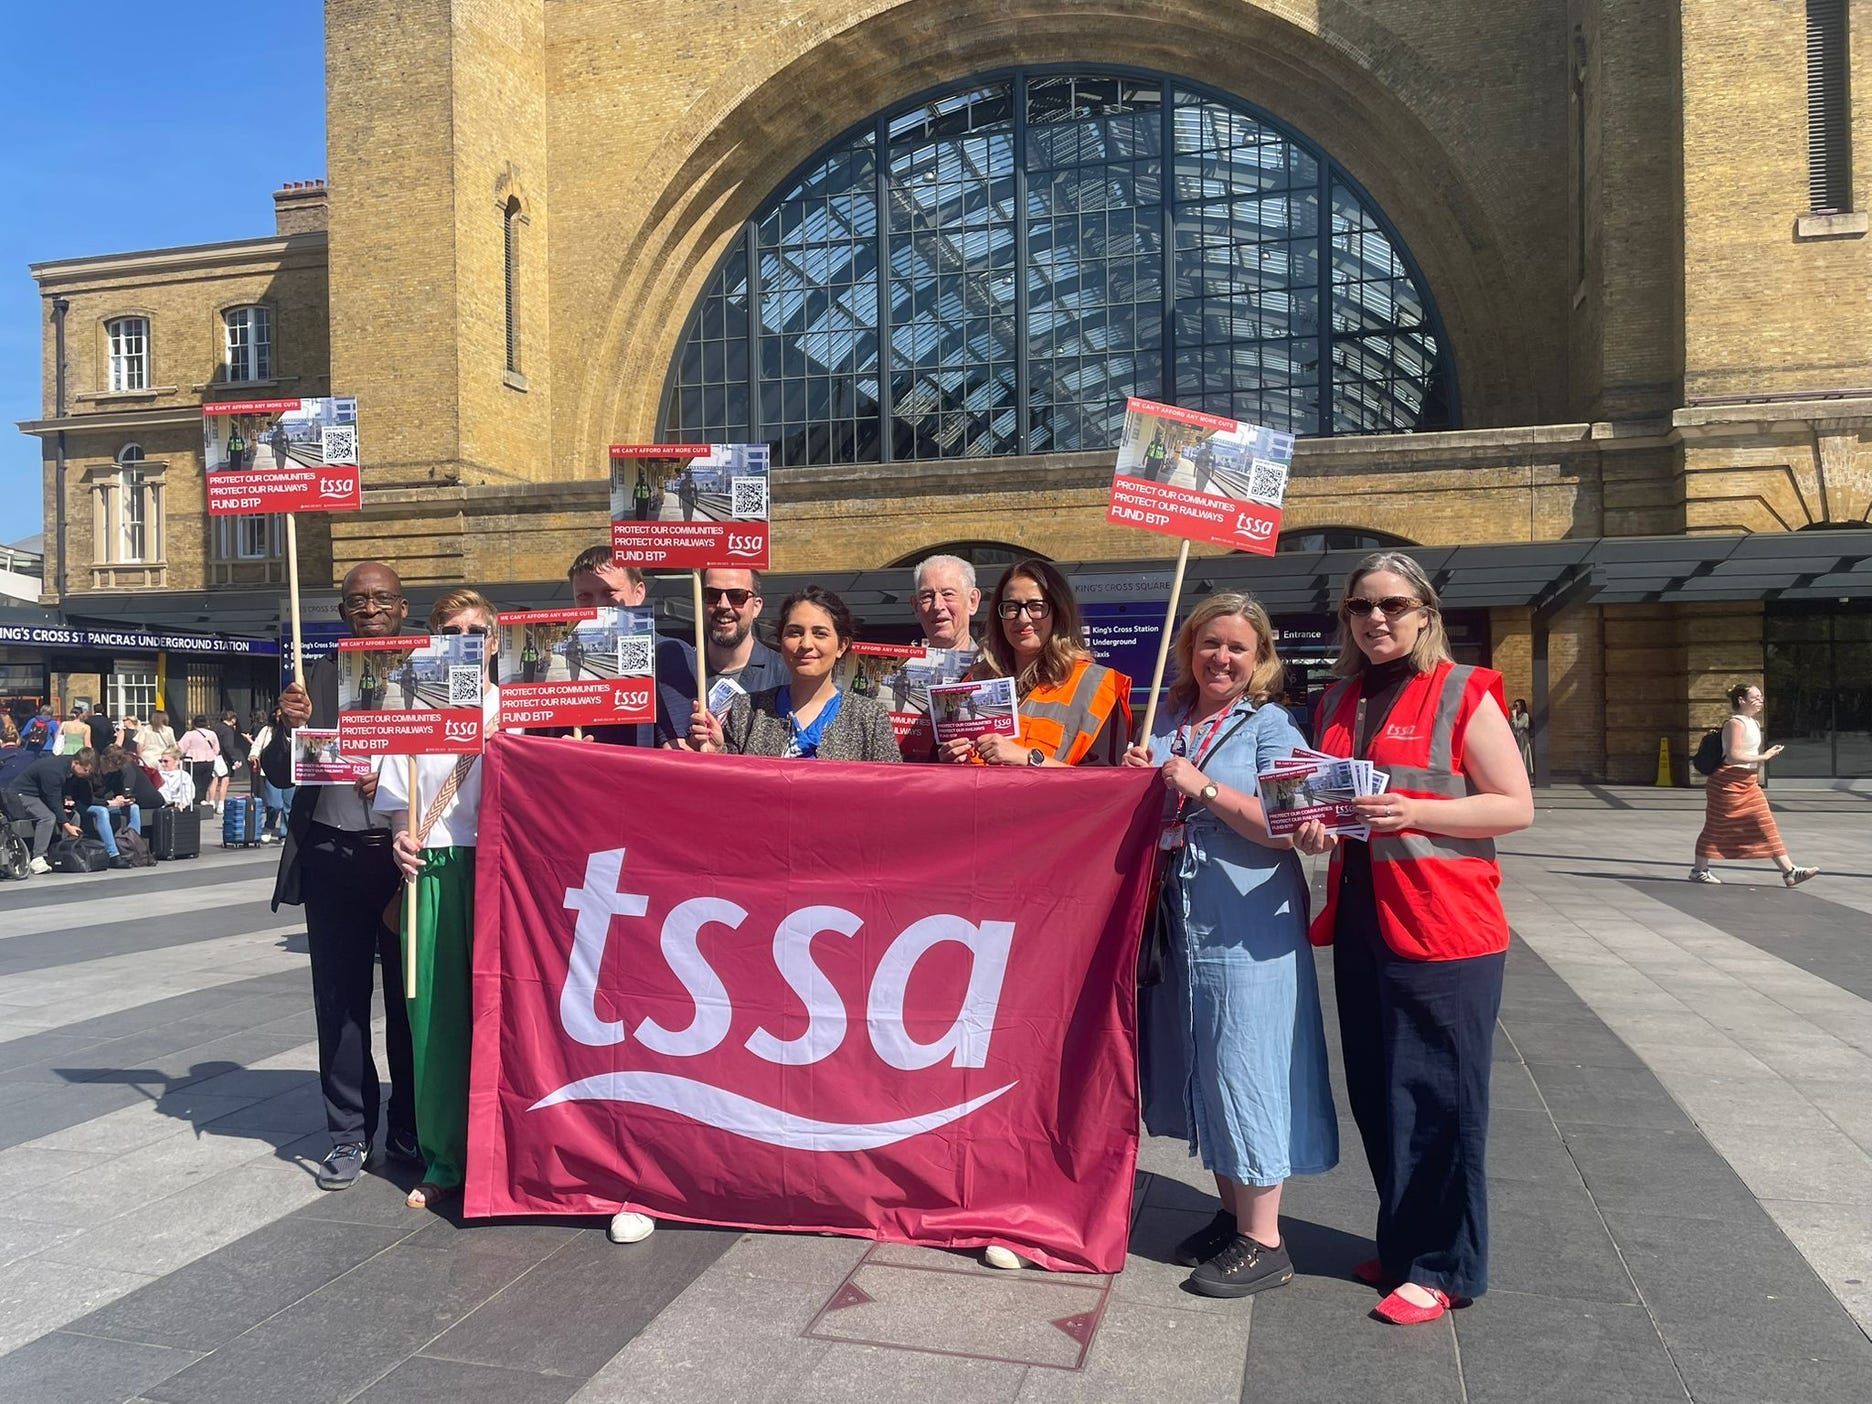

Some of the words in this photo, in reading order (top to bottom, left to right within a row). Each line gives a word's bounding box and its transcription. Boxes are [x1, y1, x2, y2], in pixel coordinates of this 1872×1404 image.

[1141, 403, 1160, 412] CAN'T
[1160, 407, 1186, 418] AFFORD
[1186, 413, 1199, 421] ANY
[1199, 416, 1217, 424] MORE
[1217, 419, 1234, 428] CUTS
[209, 474, 244, 485] PROTECT
[246, 473, 263, 483] OUR
[263, 472, 315, 482] COMMUNITIES
[210, 485, 247, 496] PROTECT
[248, 485, 267, 494] OUR
[267, 483, 308, 493] RAILWAYS
[320, 477, 354, 493] tssa
[1116, 480, 1157, 495] PROTECT
[1157, 489, 1178, 500] OUR
[1177, 493, 1236, 512] COMMUNITIES
[211, 499, 240, 509] FUND
[240, 498, 261, 508] BTP
[1114, 493, 1158, 508] PROTECT
[1158, 503, 1179, 513] OUR
[1179, 506, 1225, 523] RAILWAYS
[1111, 506, 1145, 521] FUND
[1145, 513, 1170, 526] BTP
[1236, 512, 1273, 535] tssa
[614, 526, 650, 534] PROTECT
[651, 526, 669, 534] OUR
[669, 526, 724, 535] COMMUNITIES
[614, 538, 653, 546] PROTECT
[653, 538, 673, 546] OUR
[673, 538, 715, 547] RAILWAYS
[728, 533, 763, 550] tssa
[615, 551, 644, 560] FUND
[645, 551, 666, 561] BTP
[1075, 583, 1102, 593] KING'S
[1105, 582, 1133, 592] CROSS
[1135, 581, 1171, 591] SQUARE
[1092, 626, 1112, 635] King's
[1133, 625, 1159, 633] Station
[1283, 630, 1322, 639] Entrance
[0, 626, 30, 640] ING'S
[33, 629, 70, 642] CROSS
[72, 631, 87, 643] ST.
[88, 633, 136, 646] PANCRAS
[138, 636, 212, 650] UNDERGROUND
[213, 640, 249, 652] STATION
[1092, 638, 1137, 648] Underground
[502, 688, 537, 696] PROTECT
[556, 684, 610, 694] COMMUNITIES
[502, 699, 540, 708] PROTECT
[541, 698, 560, 706] OUR
[560, 697, 602, 705] RAILWAYS
[614, 689, 649, 706] tssa
[342, 715, 374, 723] PROTECT
[375, 714, 391, 722] OUR
[391, 714, 441, 722] COMMUNITIES
[502, 712, 531, 723] FUND
[532, 711, 554, 721] BTP
[342, 727, 377, 735] PROTECT
[377, 726, 394, 734] OUR
[395, 726, 433, 734] RAILWAYS
[445, 719, 477, 736] tssa
[342, 740, 369, 749] FUND
[370, 739, 389, 749] BTP
[560, 847, 1015, 1071] tssa
